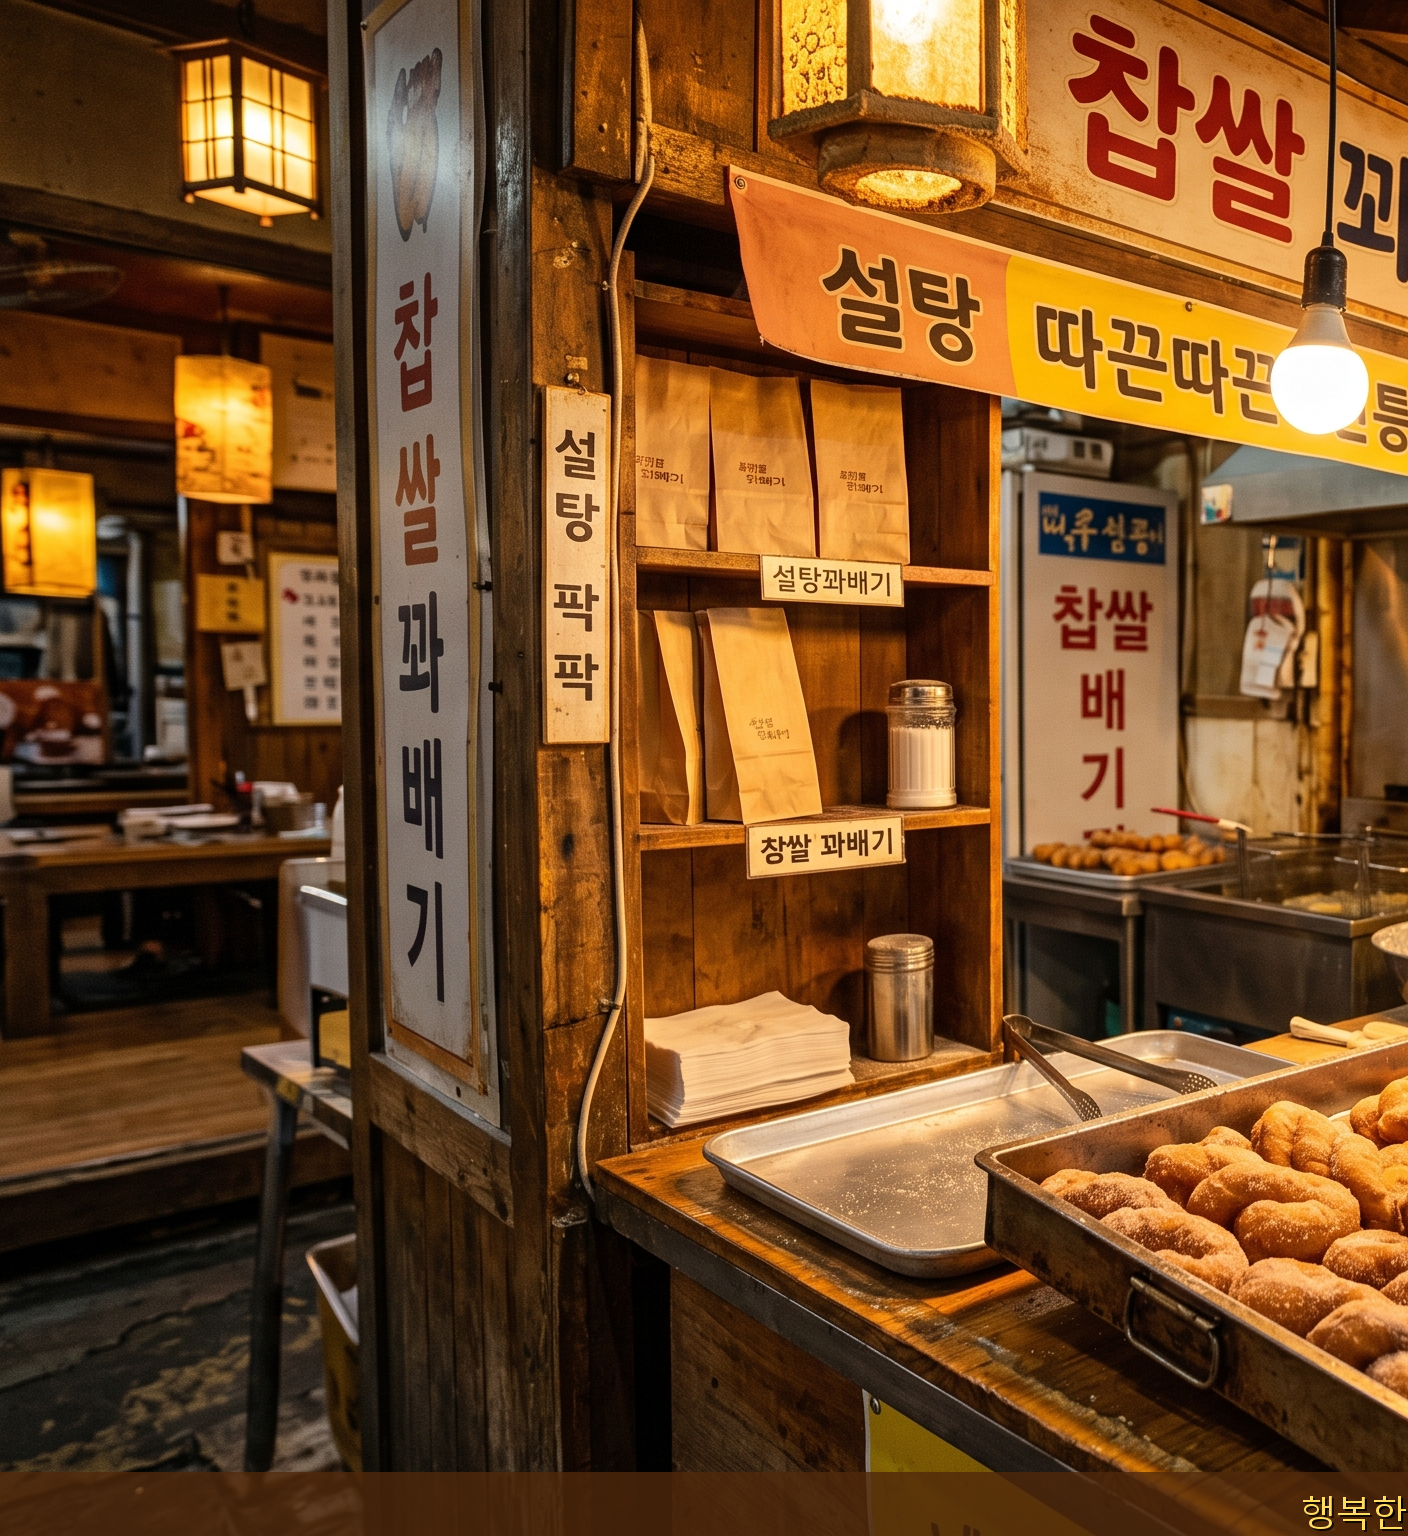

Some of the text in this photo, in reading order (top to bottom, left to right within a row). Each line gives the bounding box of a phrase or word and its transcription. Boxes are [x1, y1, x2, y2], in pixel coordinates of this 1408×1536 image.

[1068, 14, 1305, 244] 찹쌀
[822, 248, 980, 362] 설탕
[1036, 305, 1279, 425] 따끈따끈
[554, 429, 600, 701] 설탕 팍팍
[773, 565, 891, 597] 설탕꽈배기
[1052, 585, 1153, 652] 찹쌀
[820, 828, 893, 859] 꽈배기
